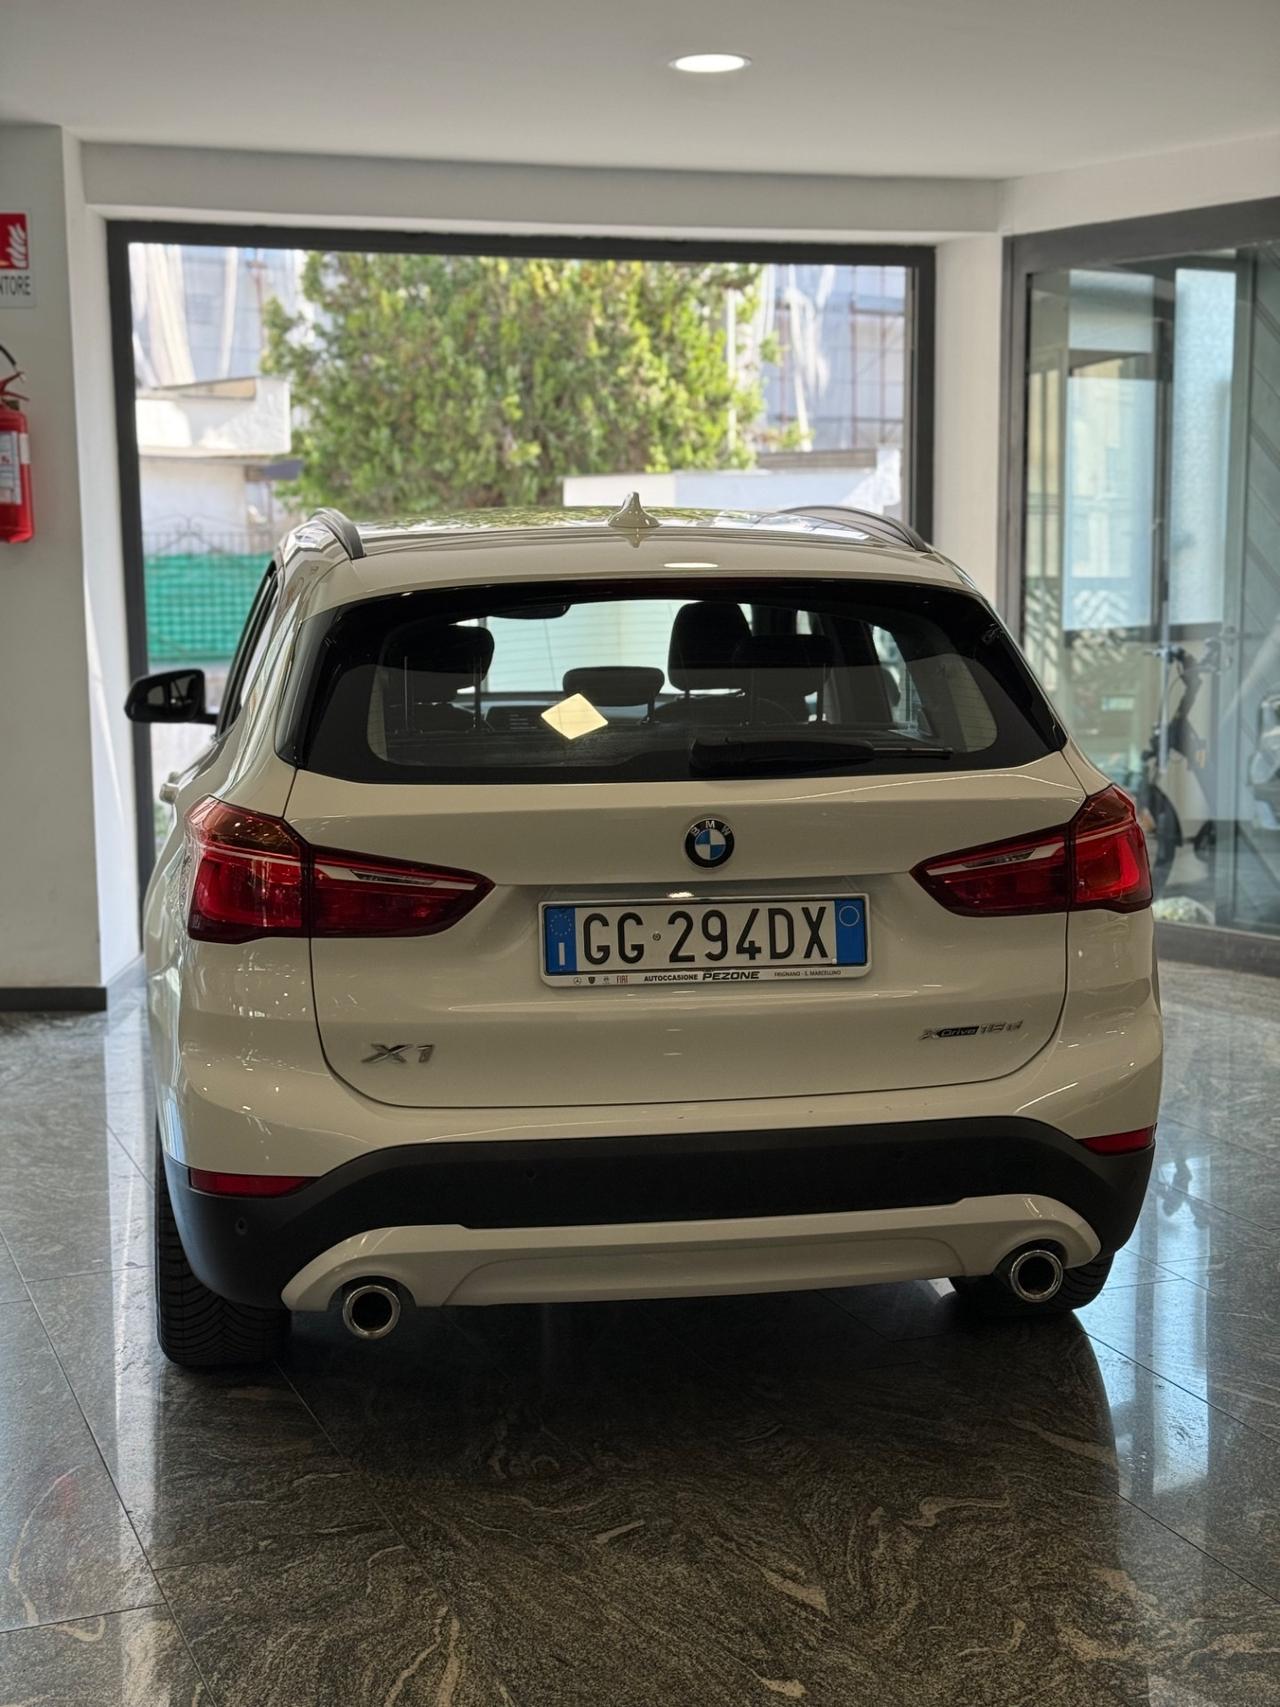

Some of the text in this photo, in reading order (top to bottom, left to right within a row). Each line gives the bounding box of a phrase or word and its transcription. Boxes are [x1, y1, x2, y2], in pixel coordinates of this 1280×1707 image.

[583, 906, 829, 965] GG 294DX
[644, 970, 760, 982] AUTOCCASIONE PEZONE
[361, 1043, 435, 1064] X1
